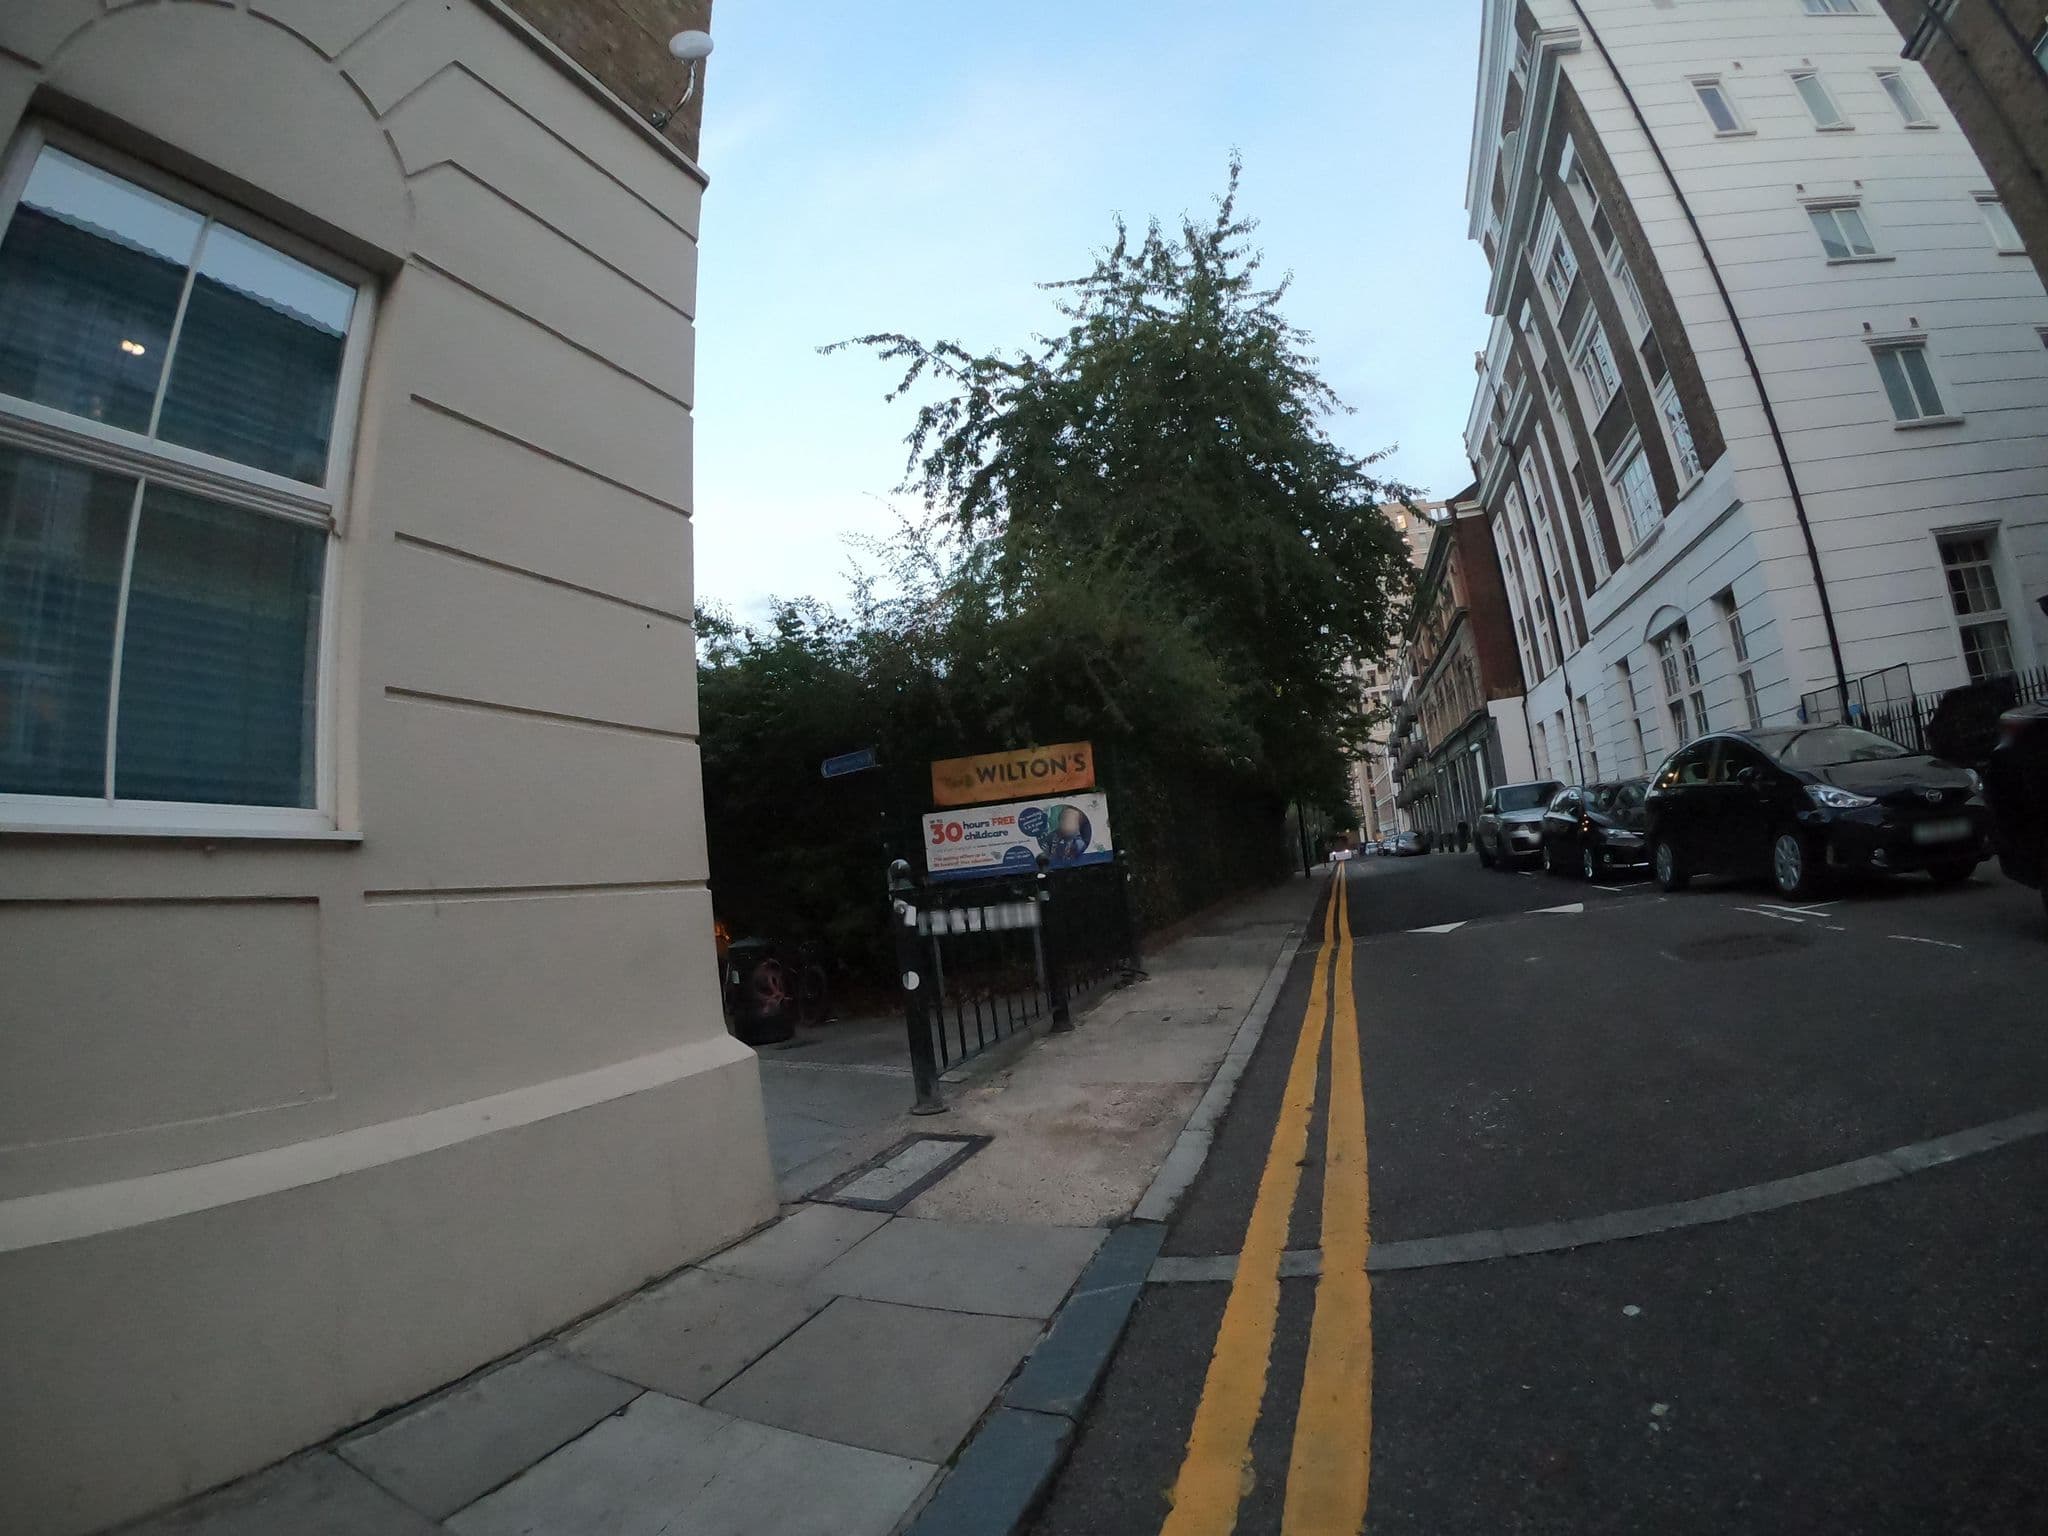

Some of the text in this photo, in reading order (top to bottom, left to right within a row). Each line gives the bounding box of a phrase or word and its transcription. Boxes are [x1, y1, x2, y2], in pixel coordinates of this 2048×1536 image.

[976, 753, 1086, 783] WILTON'S
[930, 821, 963, 845] 30
[963, 820, 990, 830] hours
[991, 815, 1016, 827] FREE
[964, 829, 1009, 841] childcare
